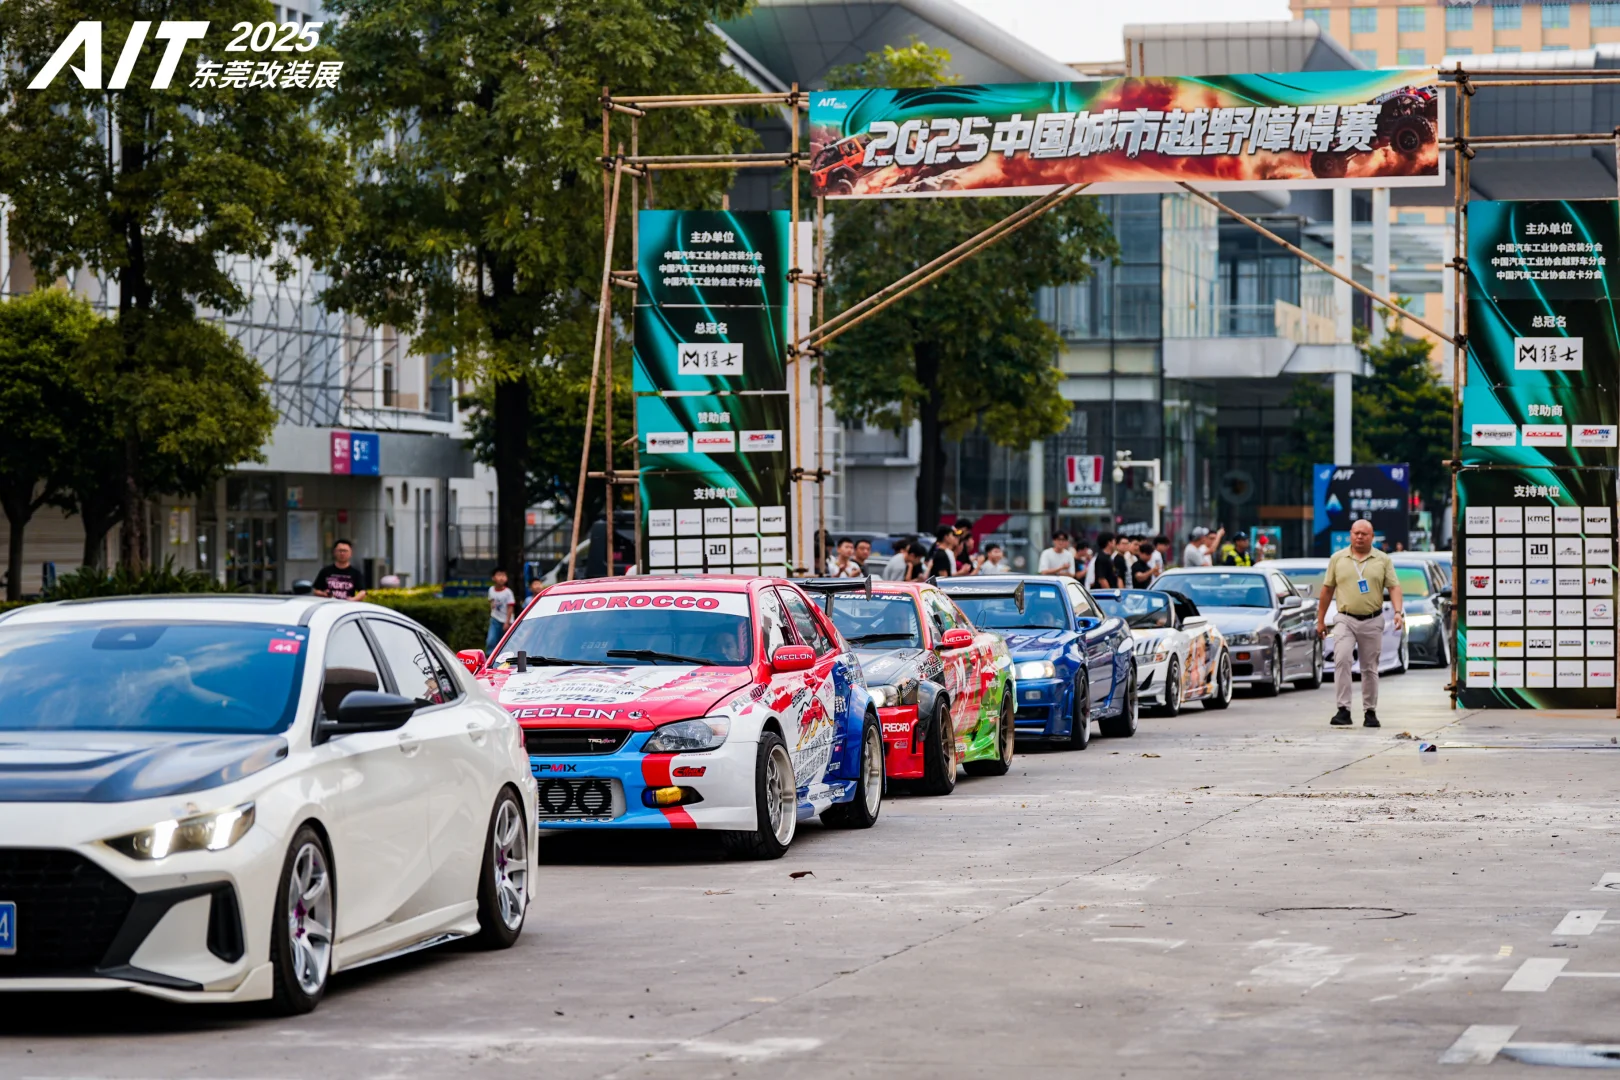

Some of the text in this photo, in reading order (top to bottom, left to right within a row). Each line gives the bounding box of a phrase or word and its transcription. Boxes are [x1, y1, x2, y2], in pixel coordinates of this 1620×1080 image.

[1525, 222, 1573, 235] 主办单位
[690, 231, 735, 243] 主办单位
[1496, 243, 1603, 253] 中国汽车工业协会改装分会
[1491, 256, 1607, 266] 中国汽车工业协会越野车分会
[1496, 269, 1603, 280] 中国汽车工业协会皮卡分会
[1531, 315, 1567, 328] 总冠名
[694, 322, 729, 334] 总冠名
[1527, 404, 1563, 417] 赞助商
[697, 412, 731, 424] 赞助商
[1333, 469, 1354, 480] AIT
[693, 487, 738, 500] 支持单位
[1513, 484, 1560, 498] 支持单位
[557, 595, 720, 613] MOROCCO
[274, 644, 292, 652] 44
[776, 653, 813, 661] MECLON
[882, 723, 910, 733] RECARO
[531, 763, 577, 772] OPMIX
